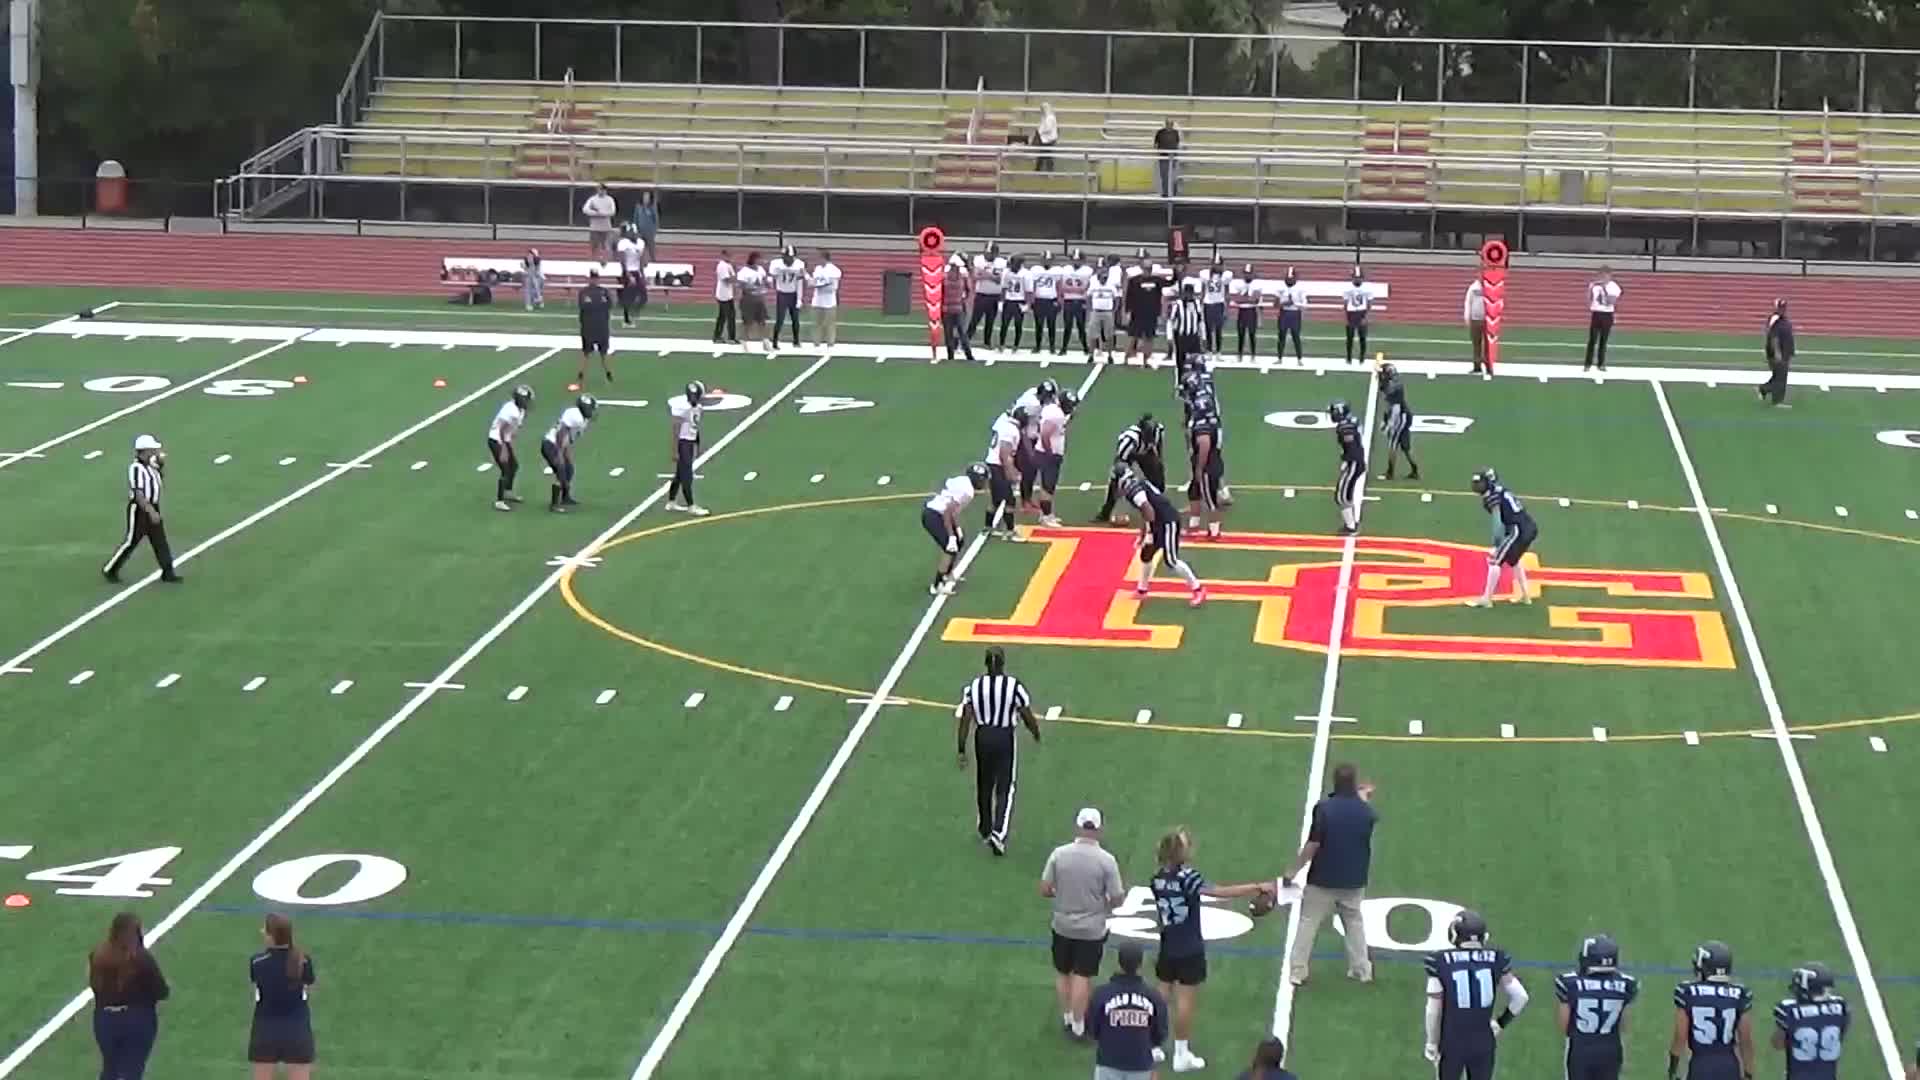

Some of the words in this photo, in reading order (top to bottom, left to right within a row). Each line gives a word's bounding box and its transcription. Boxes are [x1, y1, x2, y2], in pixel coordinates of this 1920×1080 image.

[1452, 967, 1494, 1009] 11
[1575, 998, 1625, 1035] 57
[1691, 1006, 1737, 1045] 51
[1792, 1024, 1842, 1062] 39
